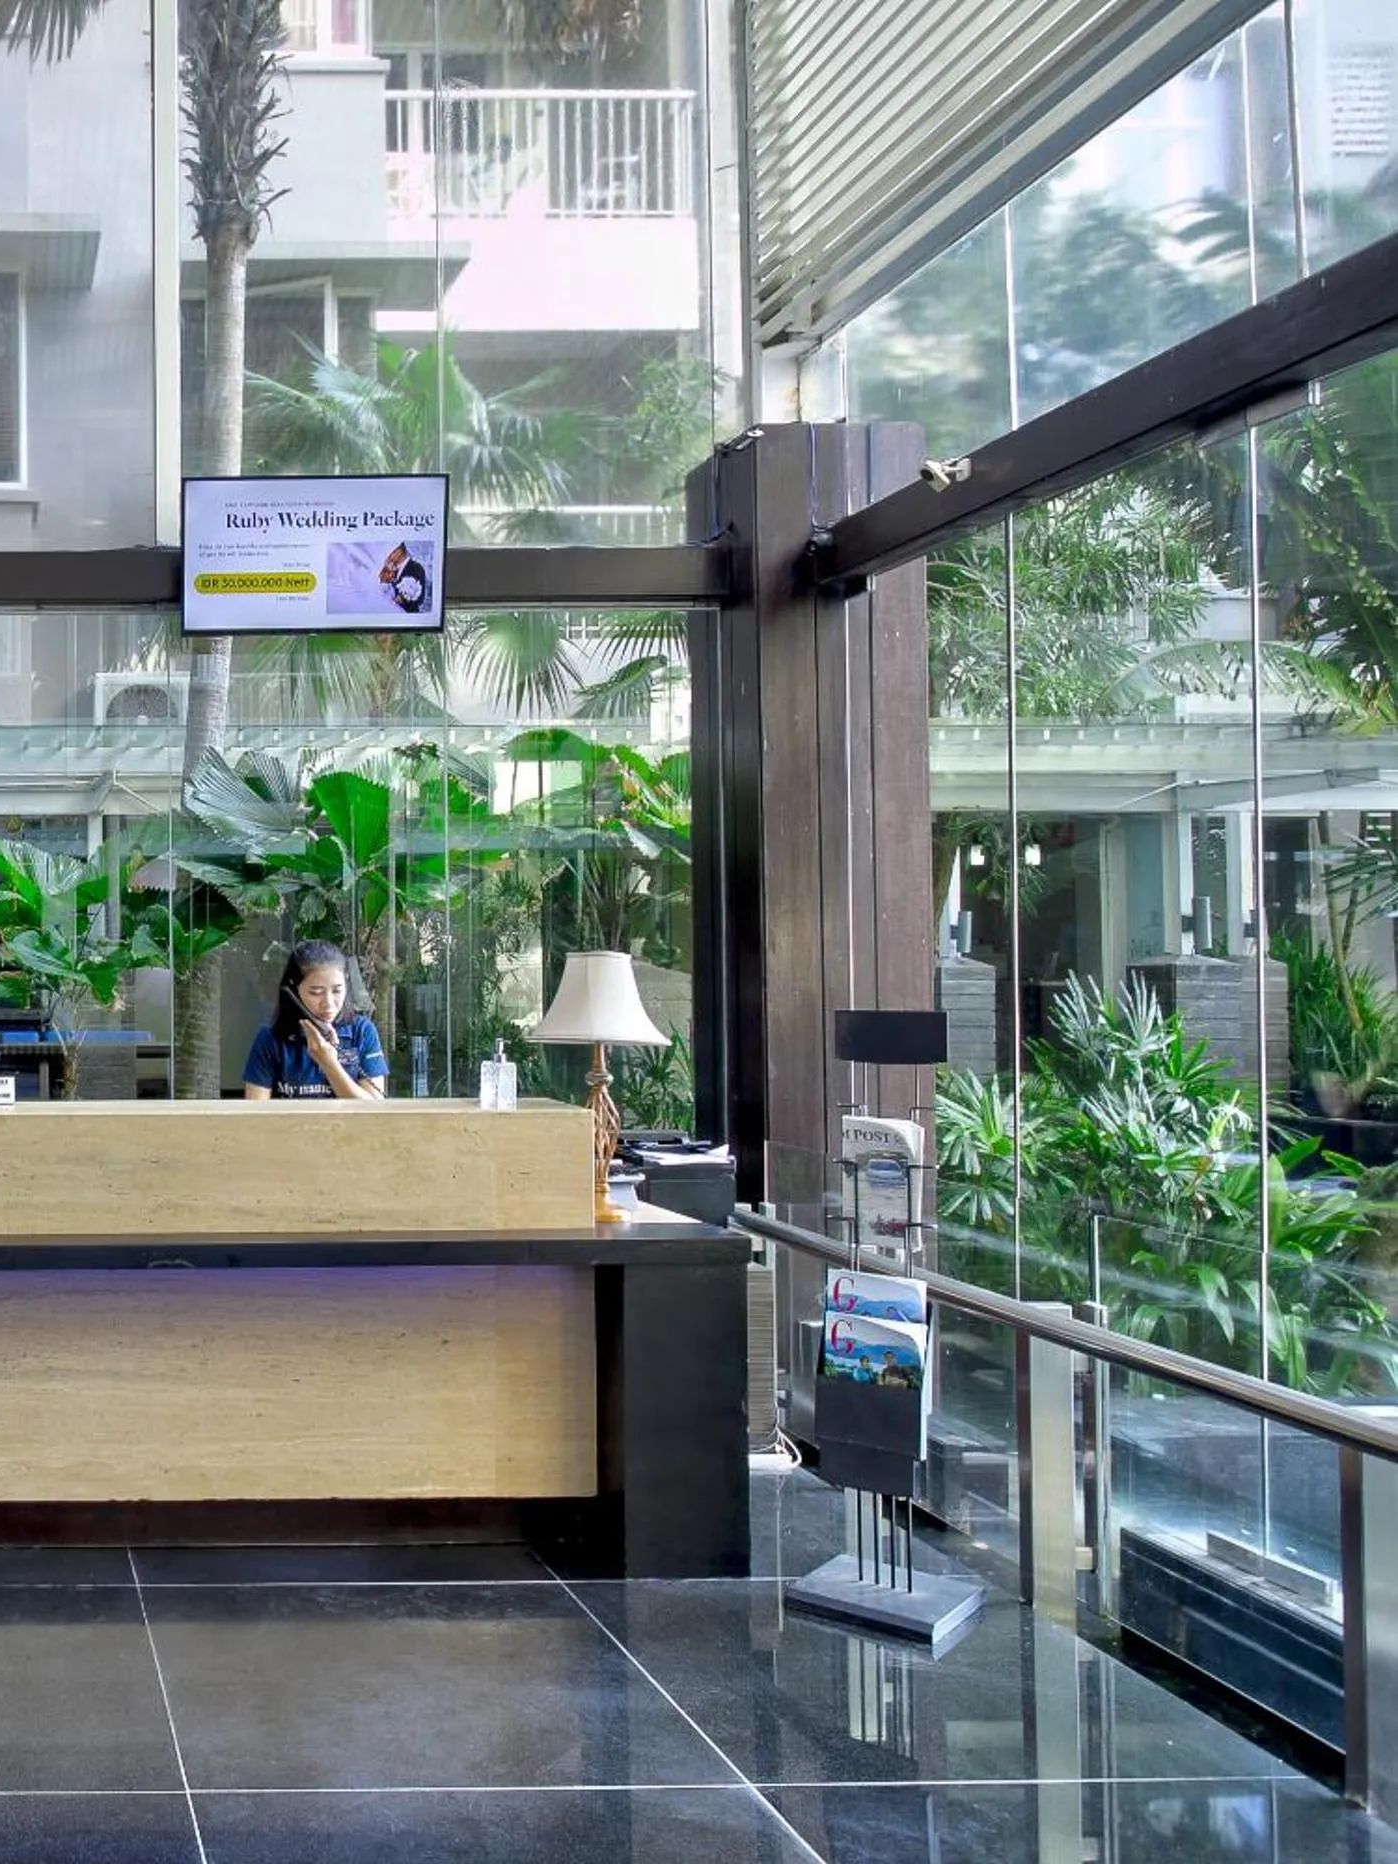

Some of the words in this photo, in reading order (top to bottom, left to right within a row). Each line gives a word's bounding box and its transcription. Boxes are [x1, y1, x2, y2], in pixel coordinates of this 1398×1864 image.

[225, 511, 272, 534] Ruby
[277, 510, 358, 532] Wedding
[363, 509, 435, 532] Package
[277, 1081, 297, 1098] My
[299, 1083, 332, 1095] name
[853, 1128, 891, 1143] POST
